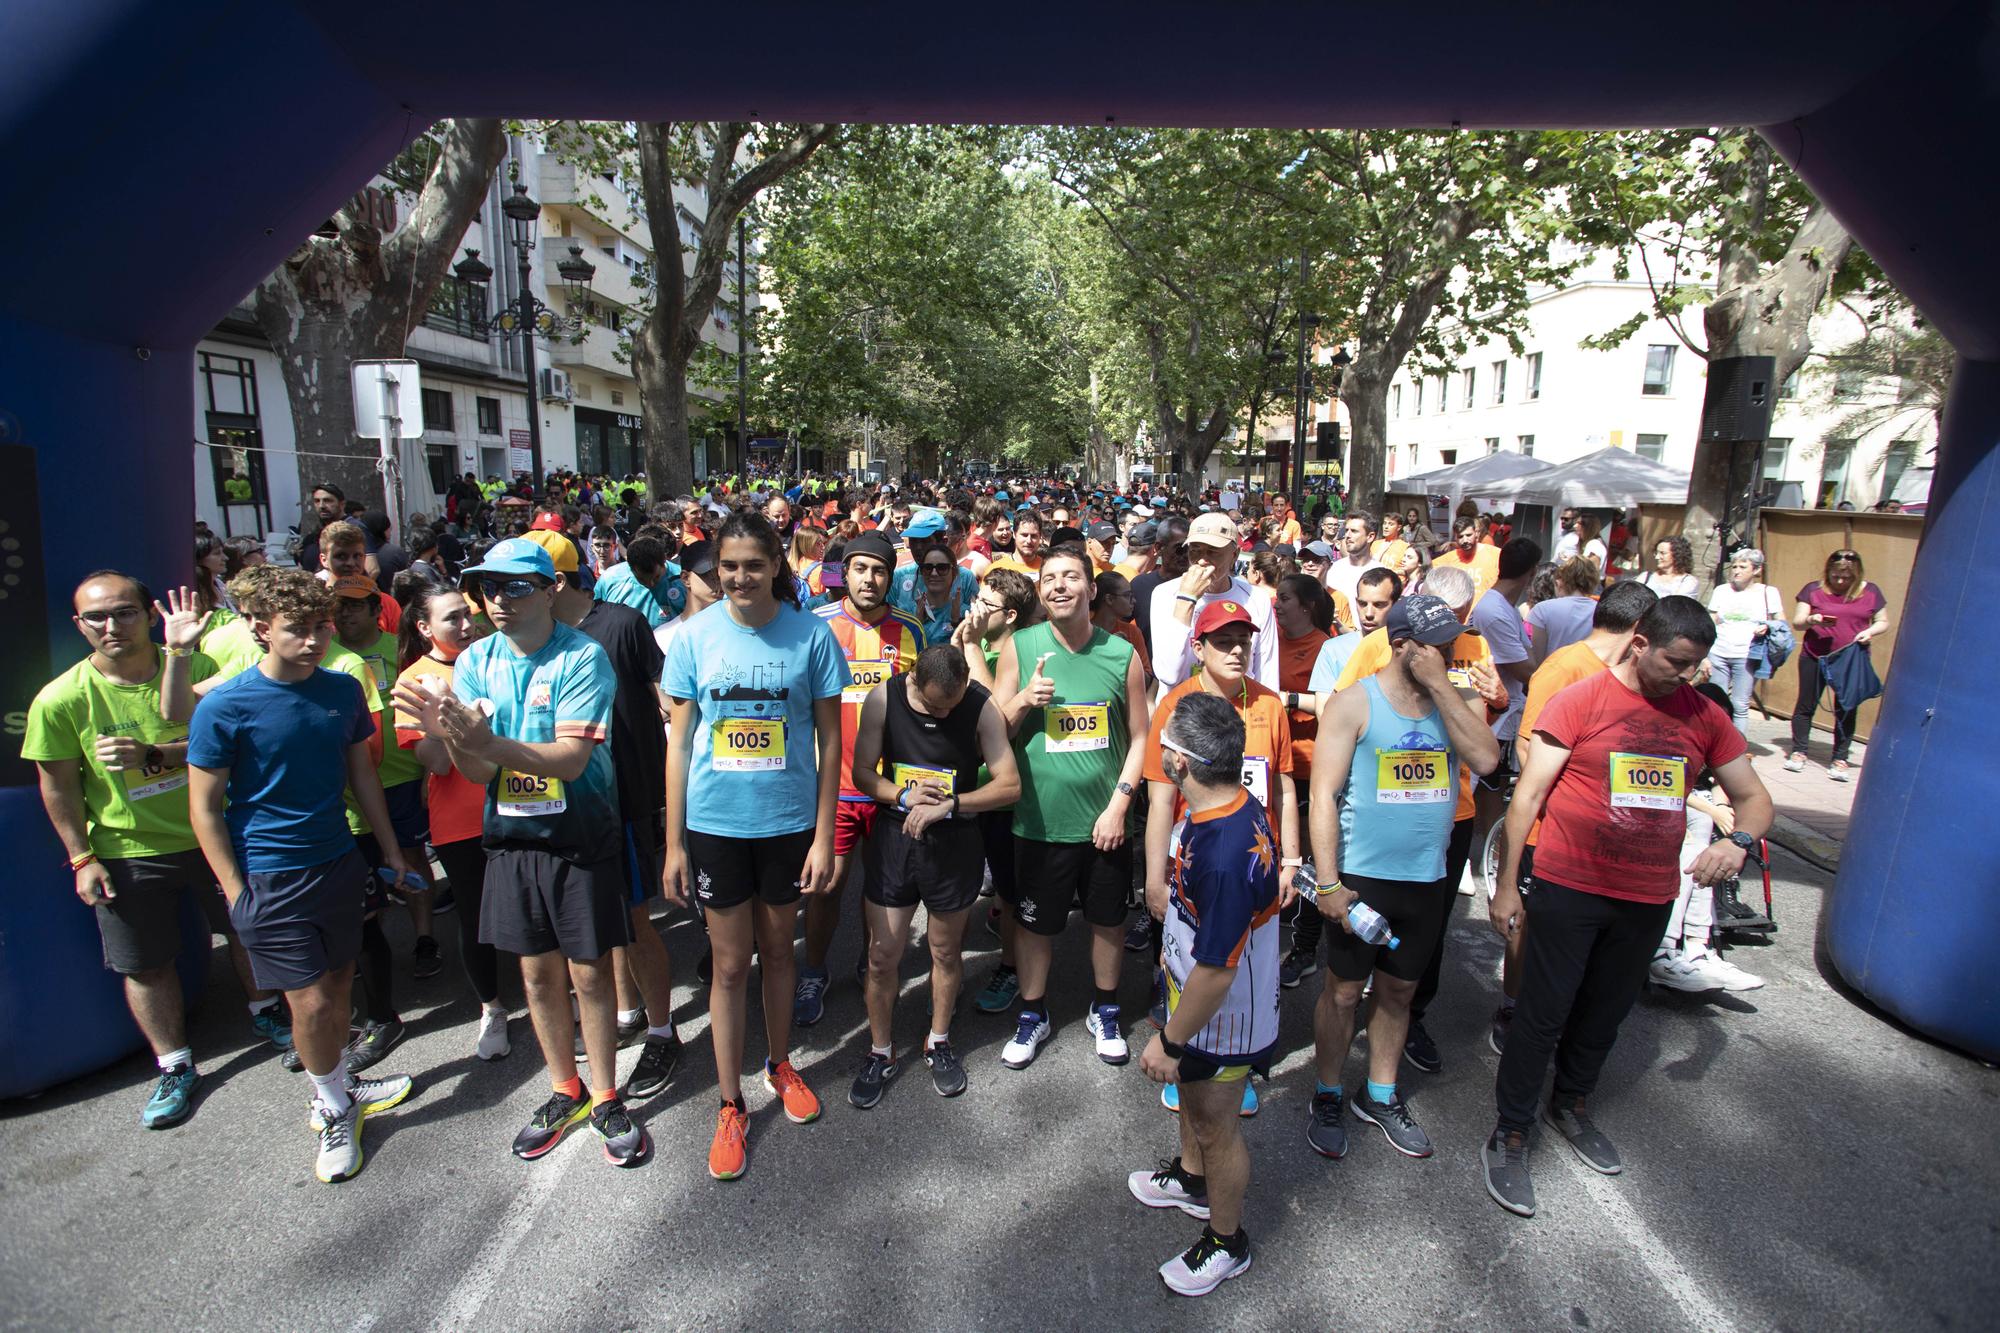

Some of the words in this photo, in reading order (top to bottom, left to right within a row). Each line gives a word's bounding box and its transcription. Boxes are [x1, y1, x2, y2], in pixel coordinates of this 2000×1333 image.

[617, 414, 633, 429] SALA
[634, 415, 642, 429] DE
[852, 671, 882, 686] 005
[1057, 716, 1097, 732] 1005
[727, 732, 771, 749] 1005
[1242, 771, 1254, 787] 5
[1393, 763, 1435, 780] 1005
[1627, 768, 1673, 787] 1005
[505, 775, 548, 793] 1005
[904, 778, 918, 789] 10
